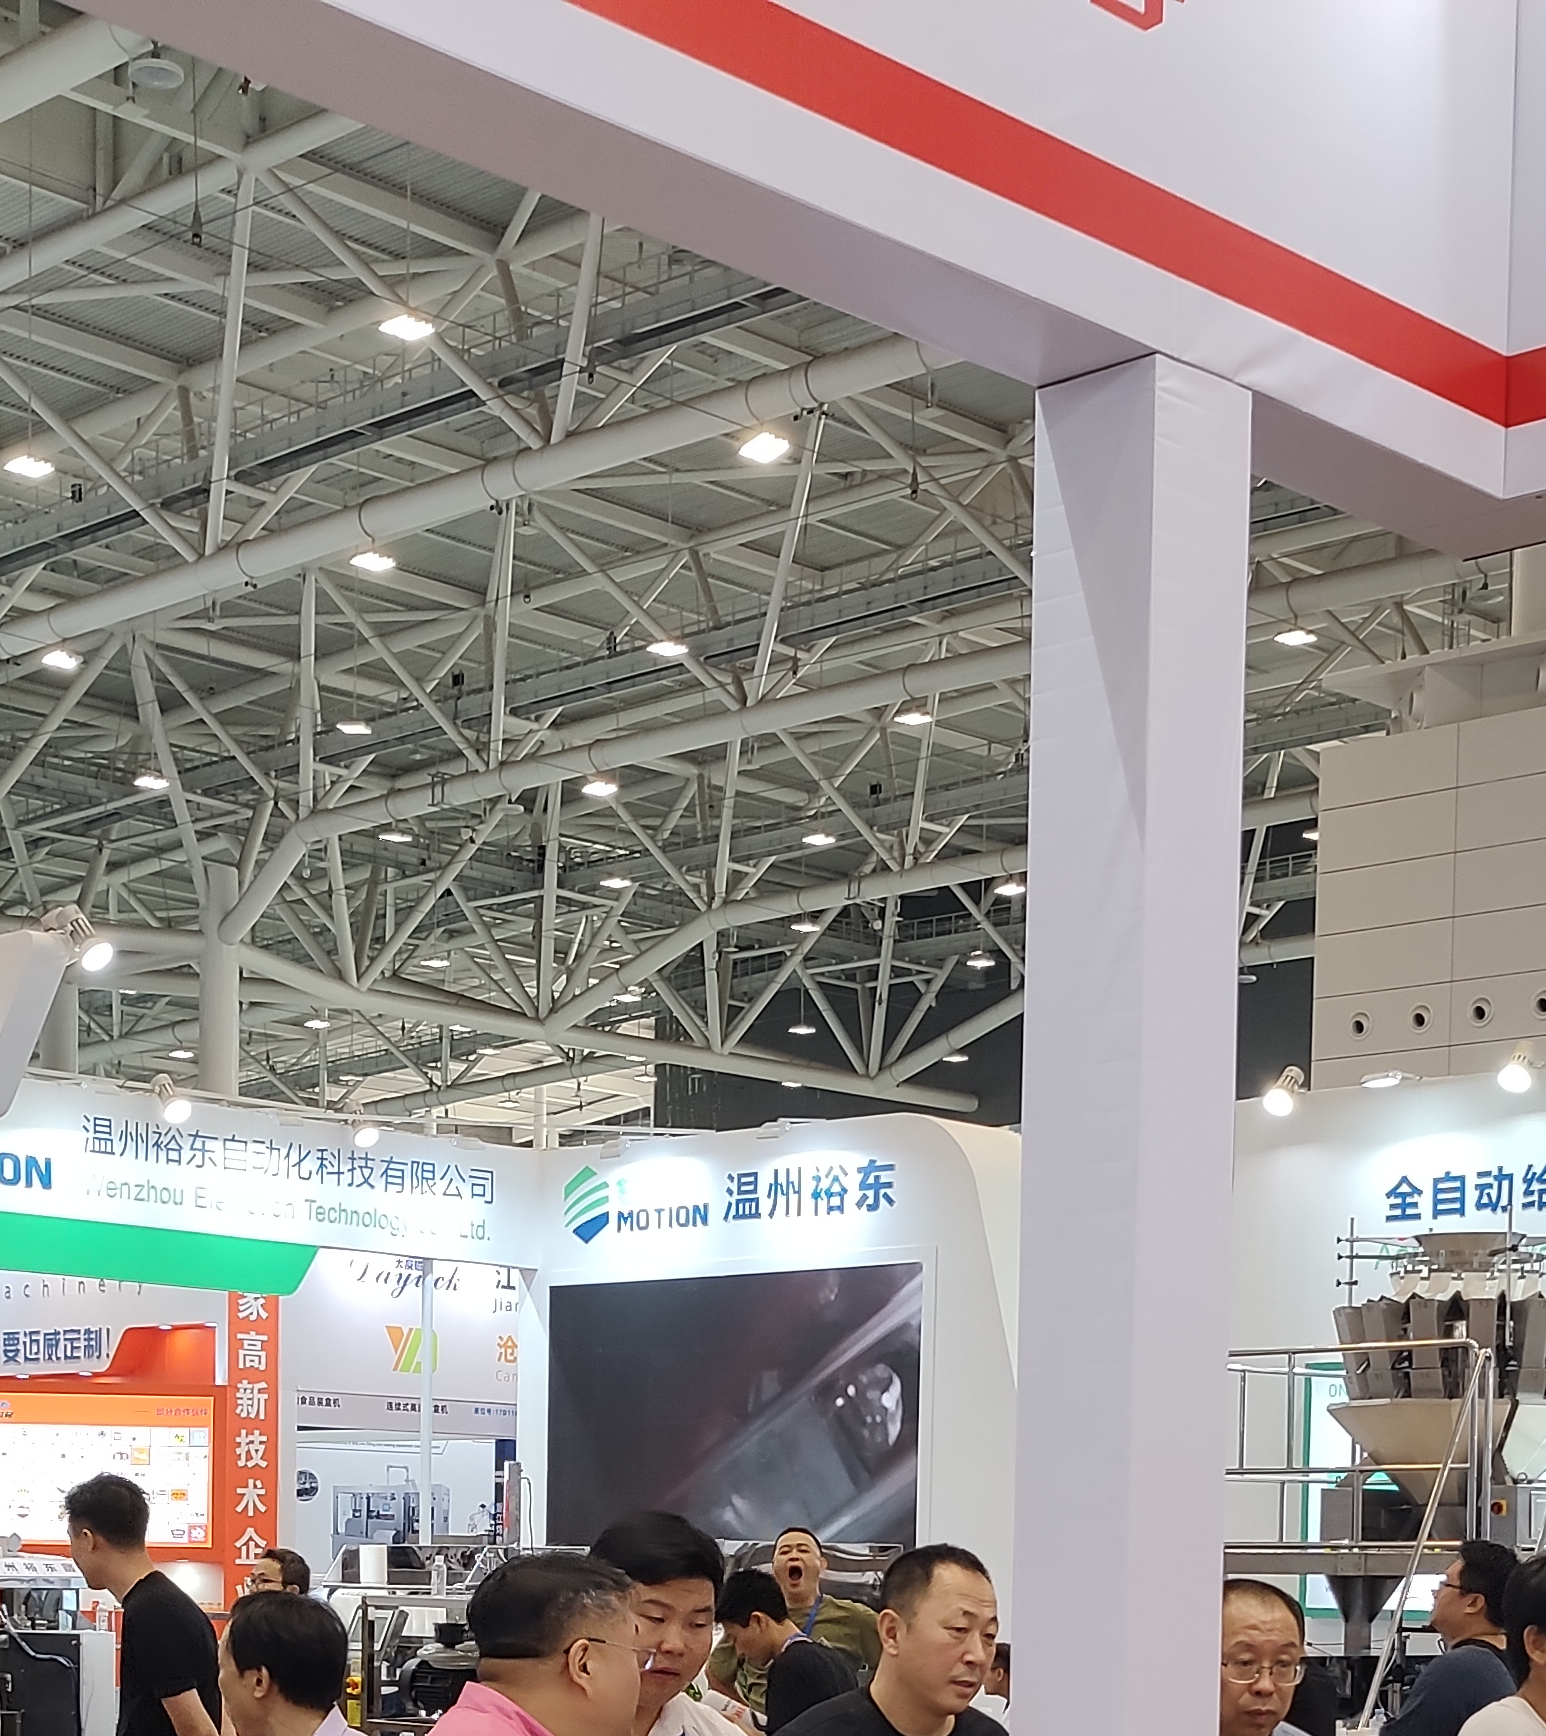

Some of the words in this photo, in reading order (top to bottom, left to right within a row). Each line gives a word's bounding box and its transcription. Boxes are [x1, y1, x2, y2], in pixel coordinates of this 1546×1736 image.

[81, 1114, 497, 1206] 温州裕东自动化科技有限公司
[722, 1158, 896, 1223] 温州裕东
[616, 1202, 710, 1233] MOTION
[296, 1394, 341, 1409] 食品装盒机
